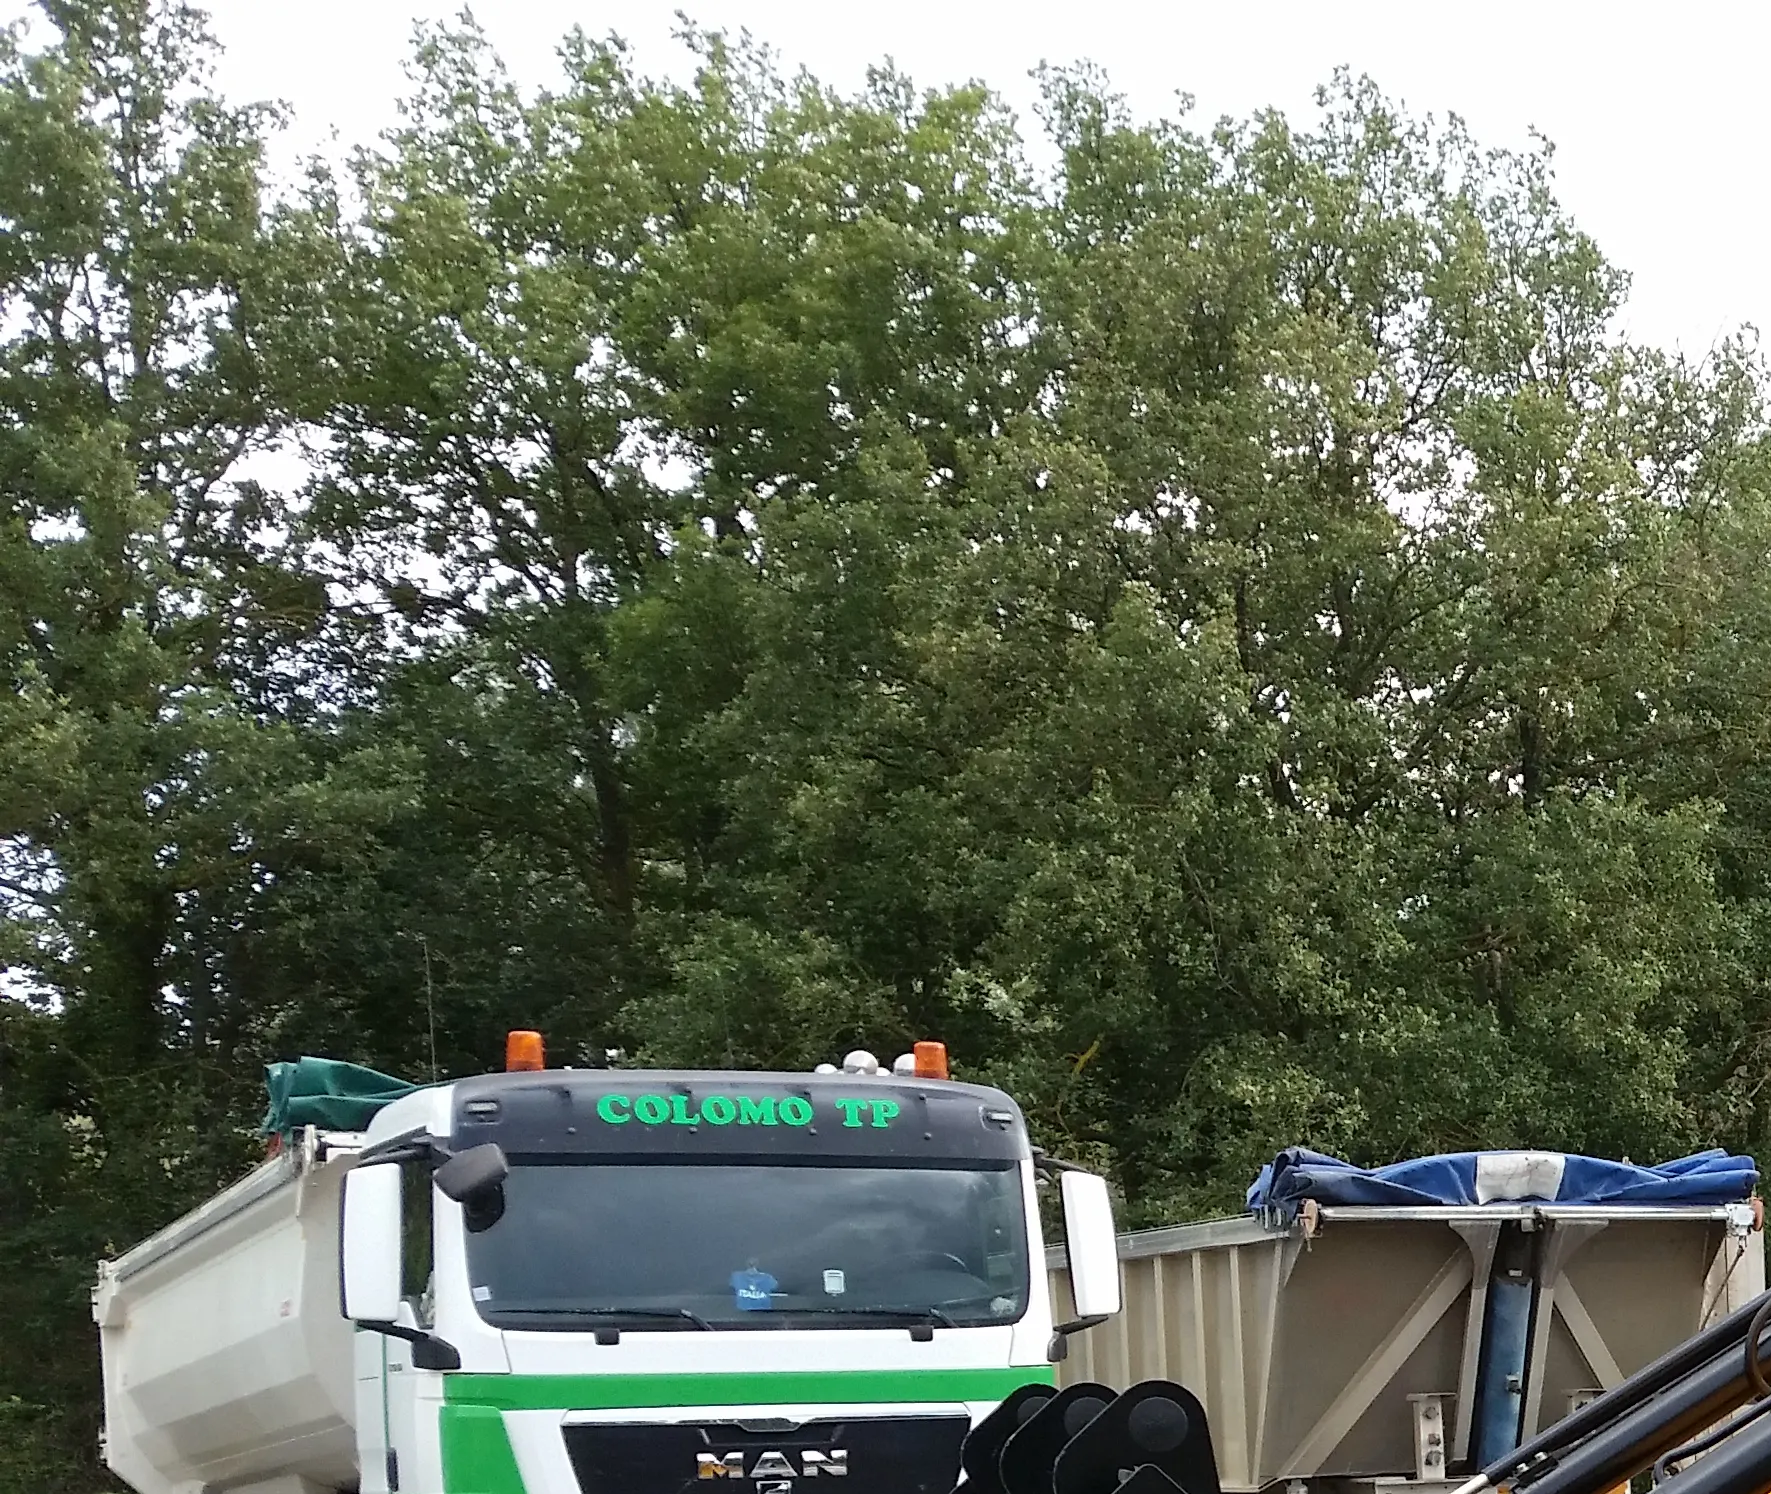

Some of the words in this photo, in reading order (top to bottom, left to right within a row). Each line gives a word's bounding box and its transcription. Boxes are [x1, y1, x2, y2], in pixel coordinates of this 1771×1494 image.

[597, 1094, 813, 1127] COLOMO
[835, 1098, 899, 1128] TP
[696, 1449, 848, 1480] MAN
